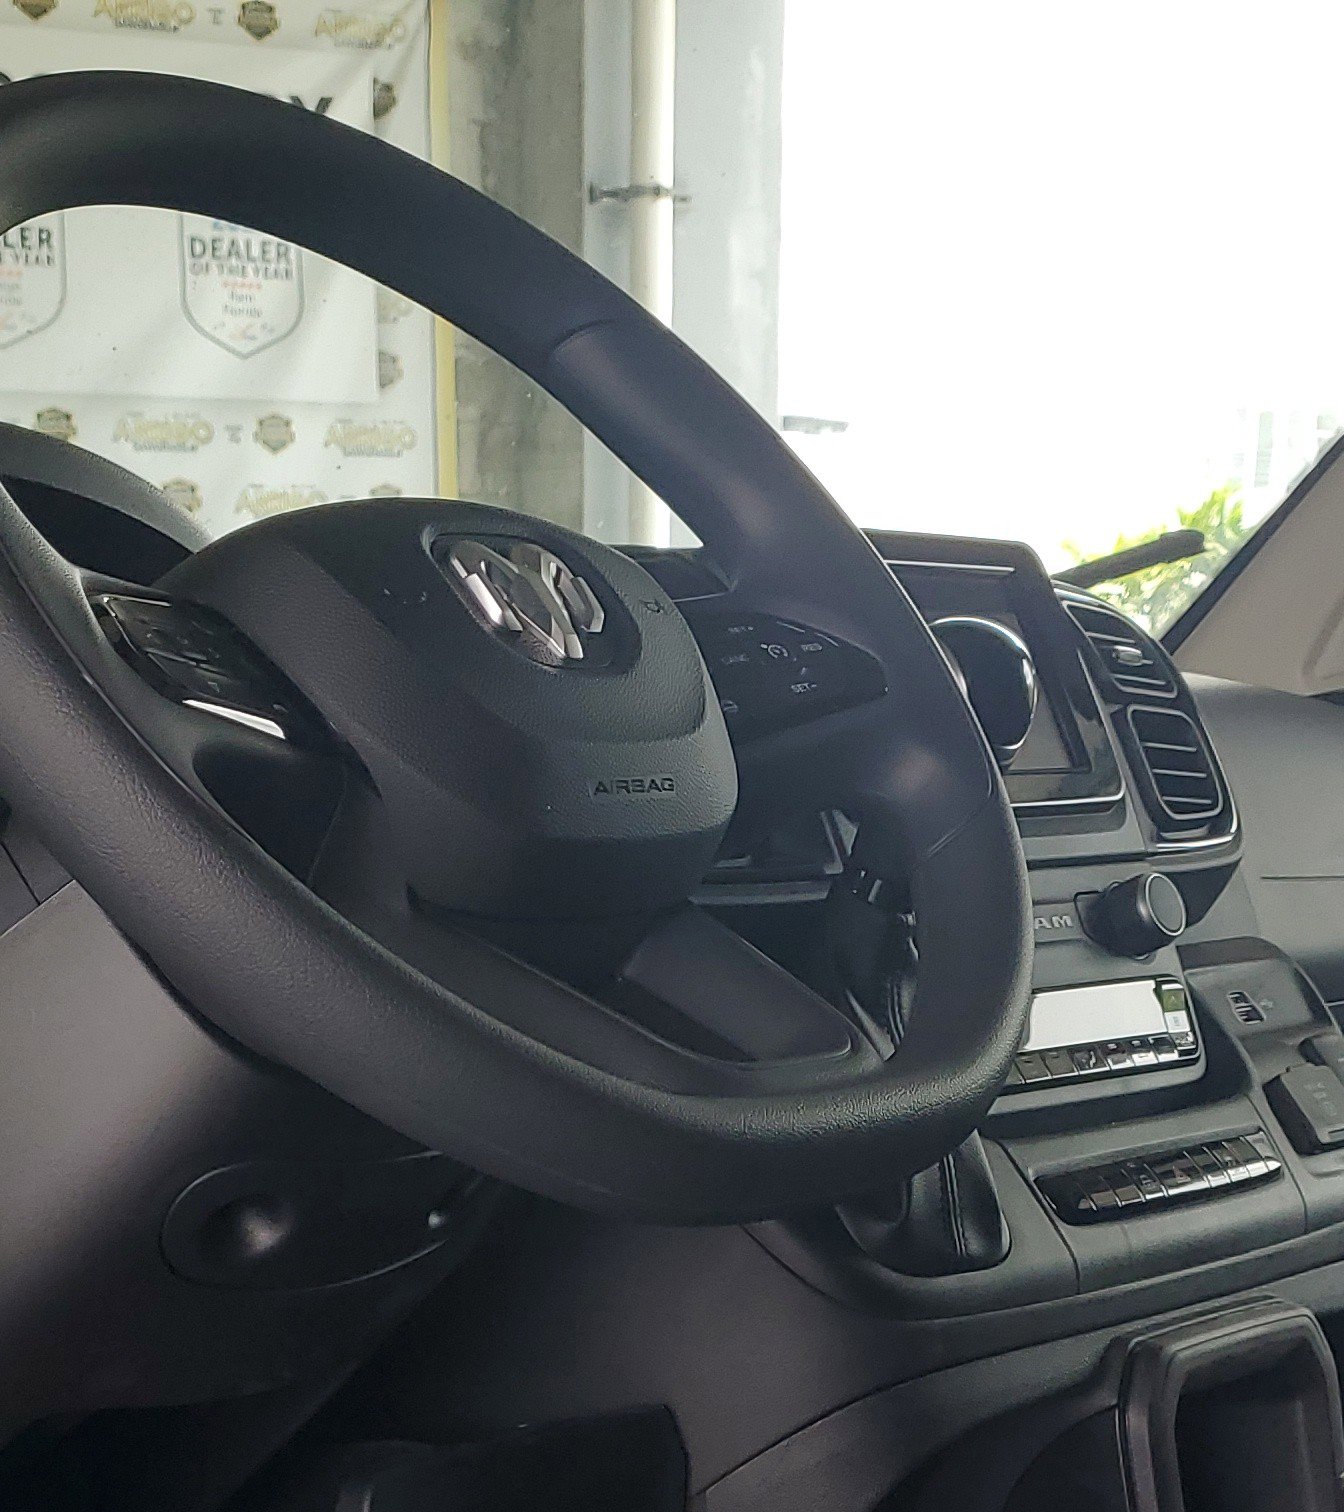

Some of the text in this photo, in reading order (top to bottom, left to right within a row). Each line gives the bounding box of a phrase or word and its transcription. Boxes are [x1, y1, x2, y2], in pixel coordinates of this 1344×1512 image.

[189, 237, 294, 266] DEALER
[594, 777, 675, 796] AIRBAG
[1034, 916, 1074, 930] AM
